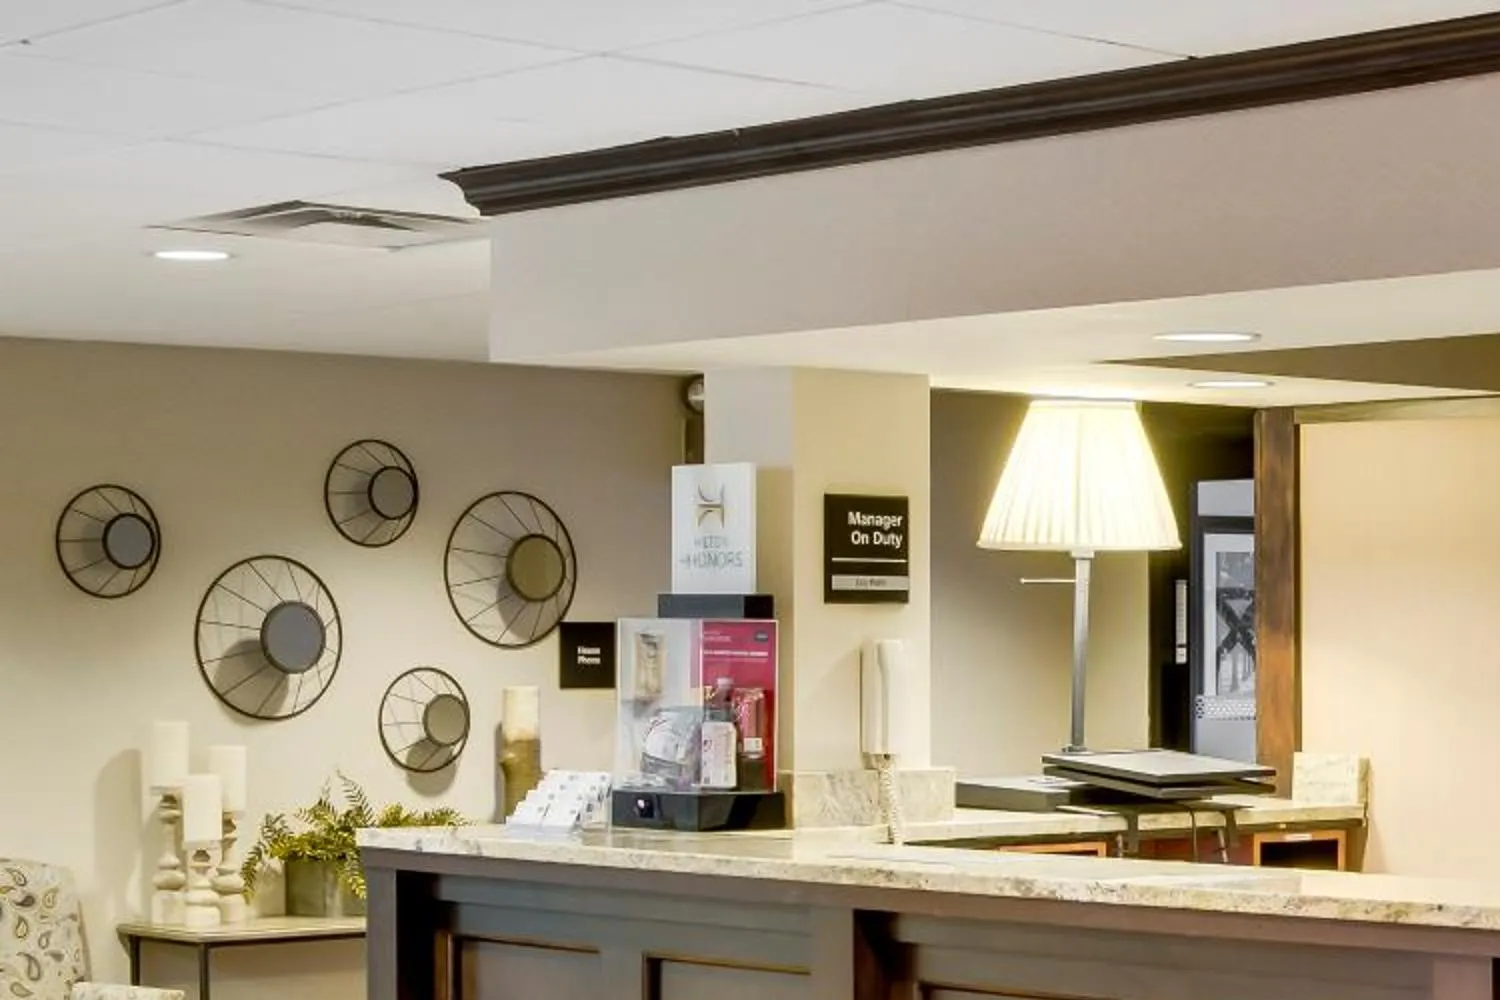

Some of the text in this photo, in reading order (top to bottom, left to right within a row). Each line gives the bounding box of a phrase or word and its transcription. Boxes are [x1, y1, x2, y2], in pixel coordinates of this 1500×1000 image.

[847, 511, 903, 530] Manager
[851, 531, 903, 549] On Duty
